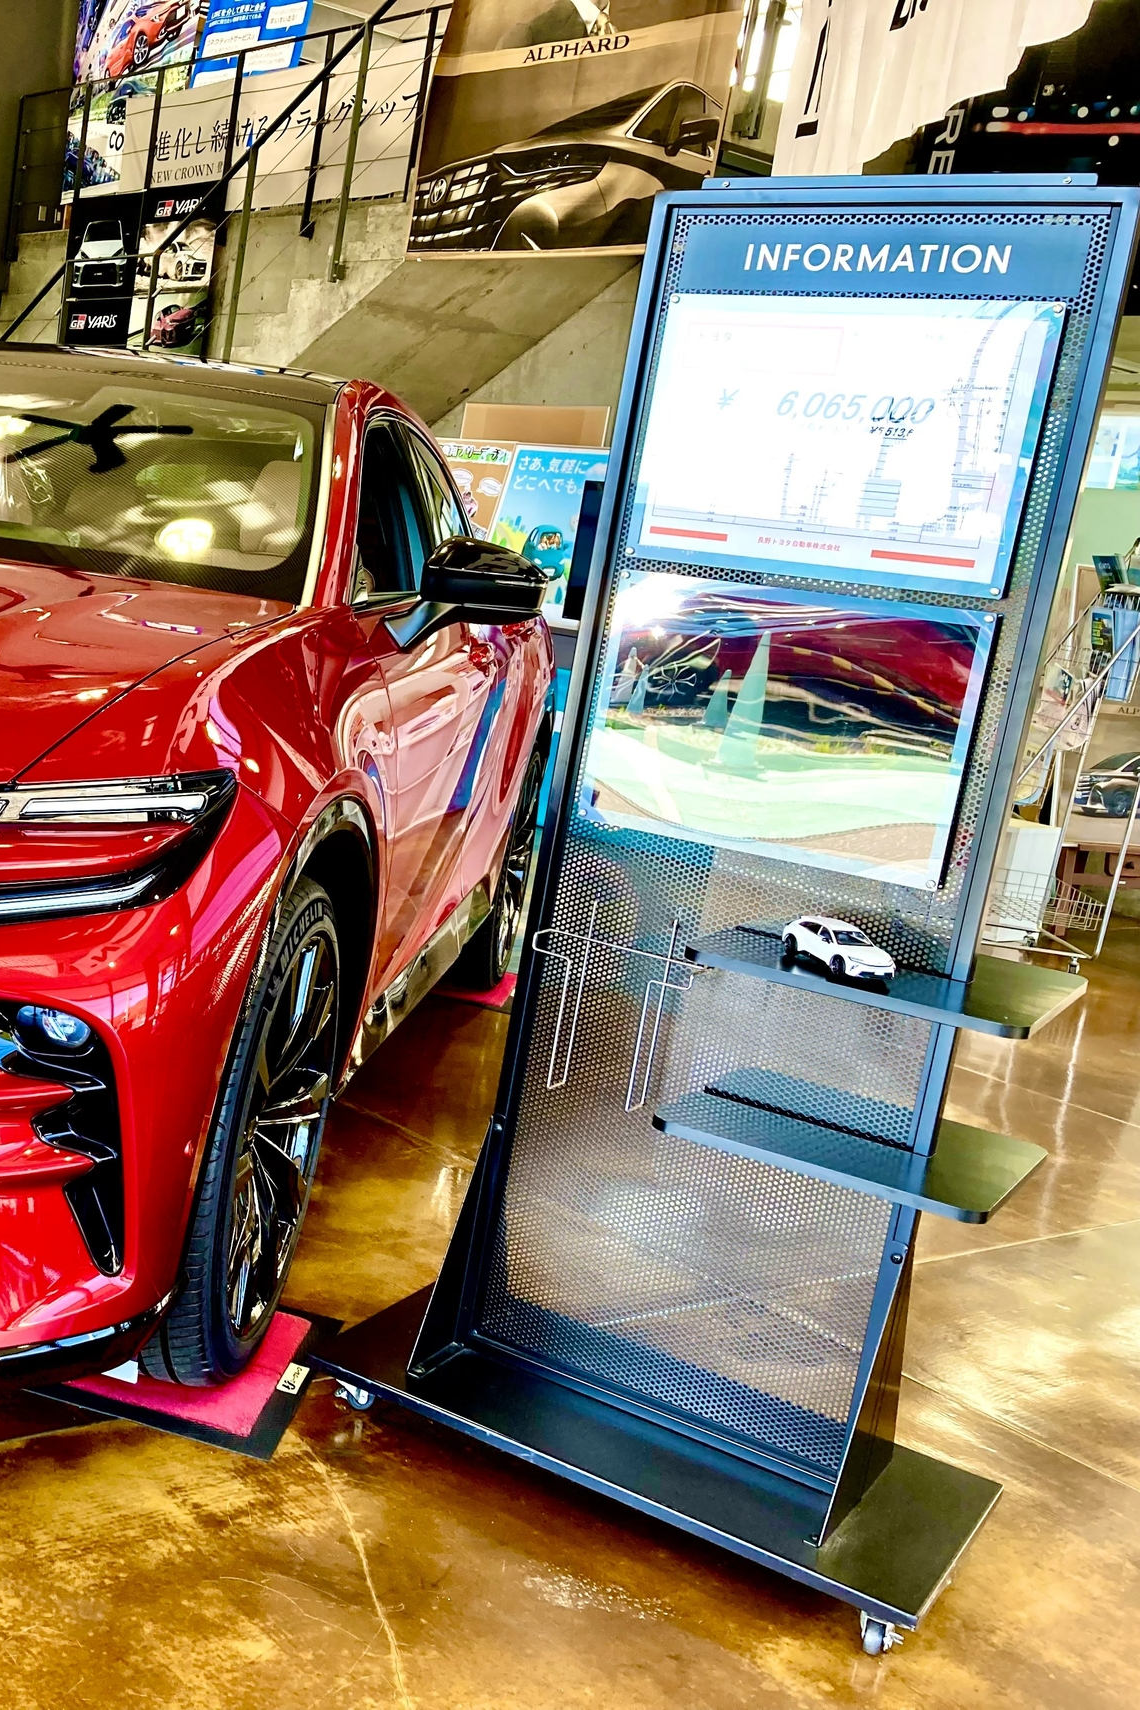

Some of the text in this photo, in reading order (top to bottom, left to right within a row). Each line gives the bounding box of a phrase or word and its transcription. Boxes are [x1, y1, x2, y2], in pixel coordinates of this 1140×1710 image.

[523, 34, 630, 64] ALPHARD
[150, 169, 172, 185] NEW
[175, 163, 214, 180] CROWN
[175, 197, 206, 215] YAR
[743, 243, 1012, 274] INFORMATION
[88, 314, 117, 328] YARIS
[776, 391, 935, 424] 6,065,000
[519, 456, 589, 474] さあ、気軽に
[513, 474, 583, 495] どこへでも。
[757, 536, 841, 551] 長野トヨタ自動車株式会社
[280, 902, 323, 973] MICHELIN
